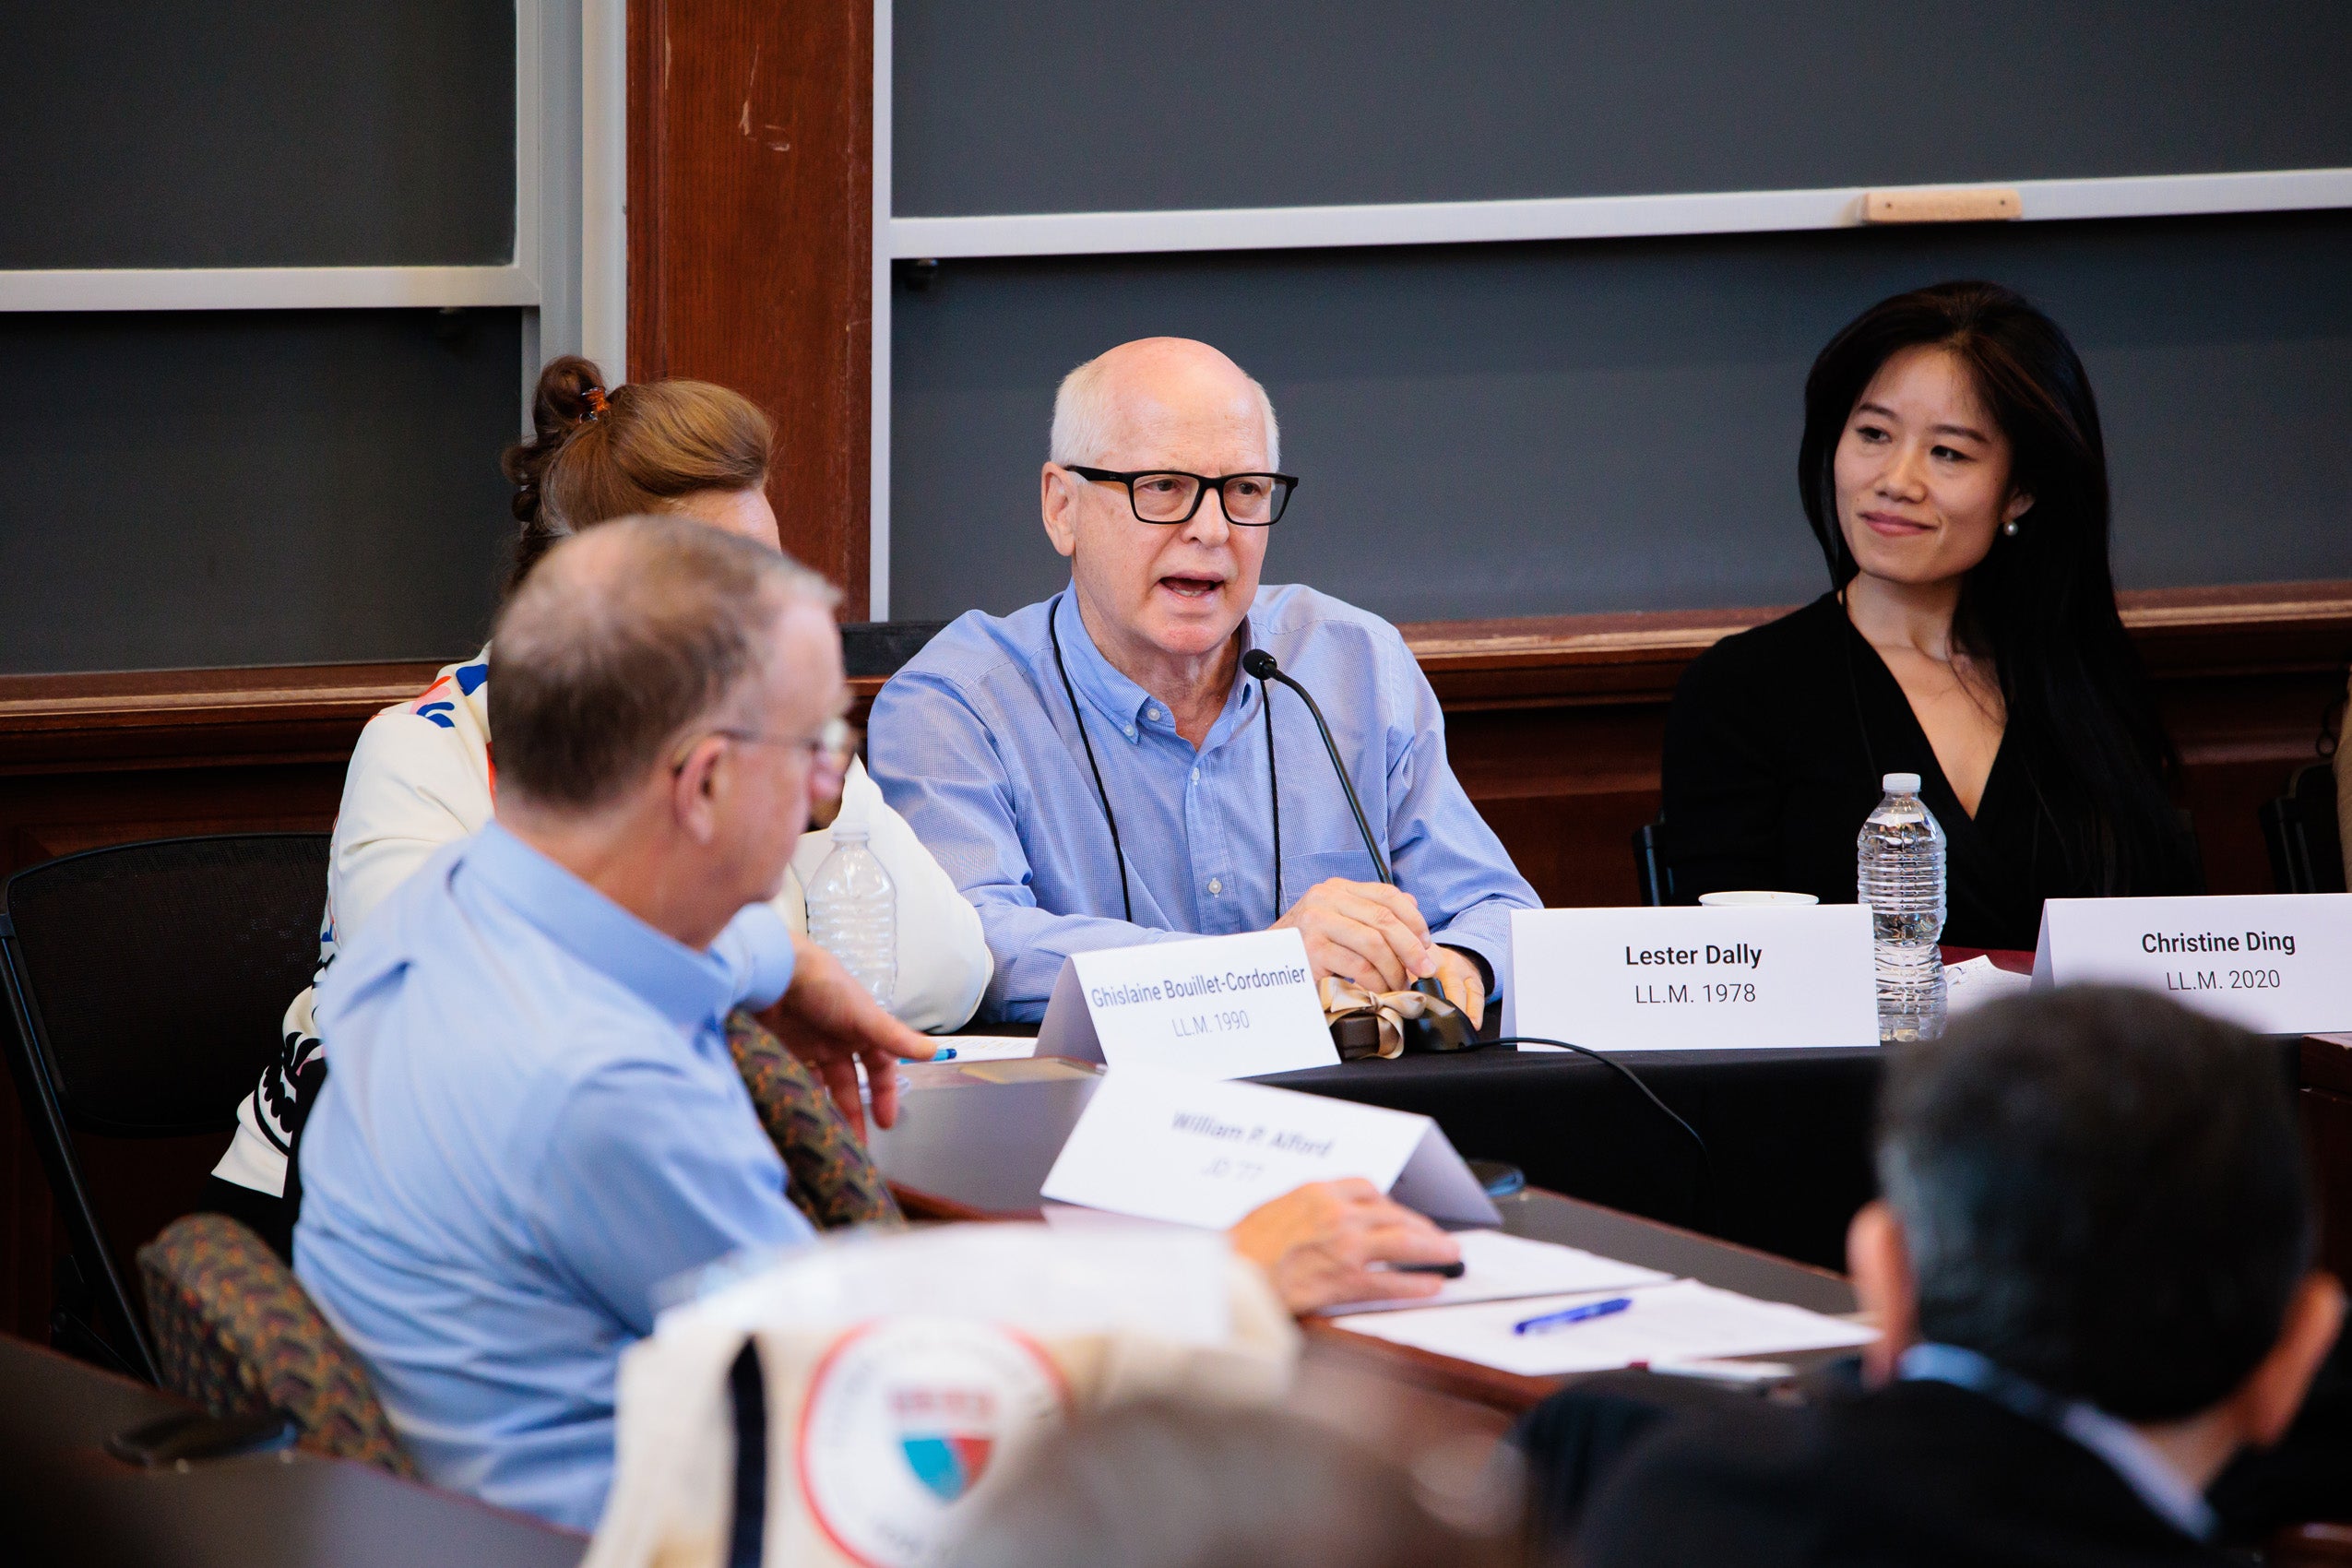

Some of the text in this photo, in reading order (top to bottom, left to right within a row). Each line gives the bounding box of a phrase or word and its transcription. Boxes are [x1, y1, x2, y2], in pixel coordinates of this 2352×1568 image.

[2142, 931, 2296, 956] Christine Ding
[1625, 944, 1763, 969] Lester Dally
[1091, 965, 1306, 1008] Ghislaine Bouillet-Cordonnier
[2166, 969, 2281, 991] LL.M. 2020
[1634, 983, 1756, 1004] LL.M. 1978
[1171, 1010, 1250, 1038] LL.M. 1990
[1172, 1111, 1242, 1141] William
[1270, 1131, 1334, 1158] Alford
